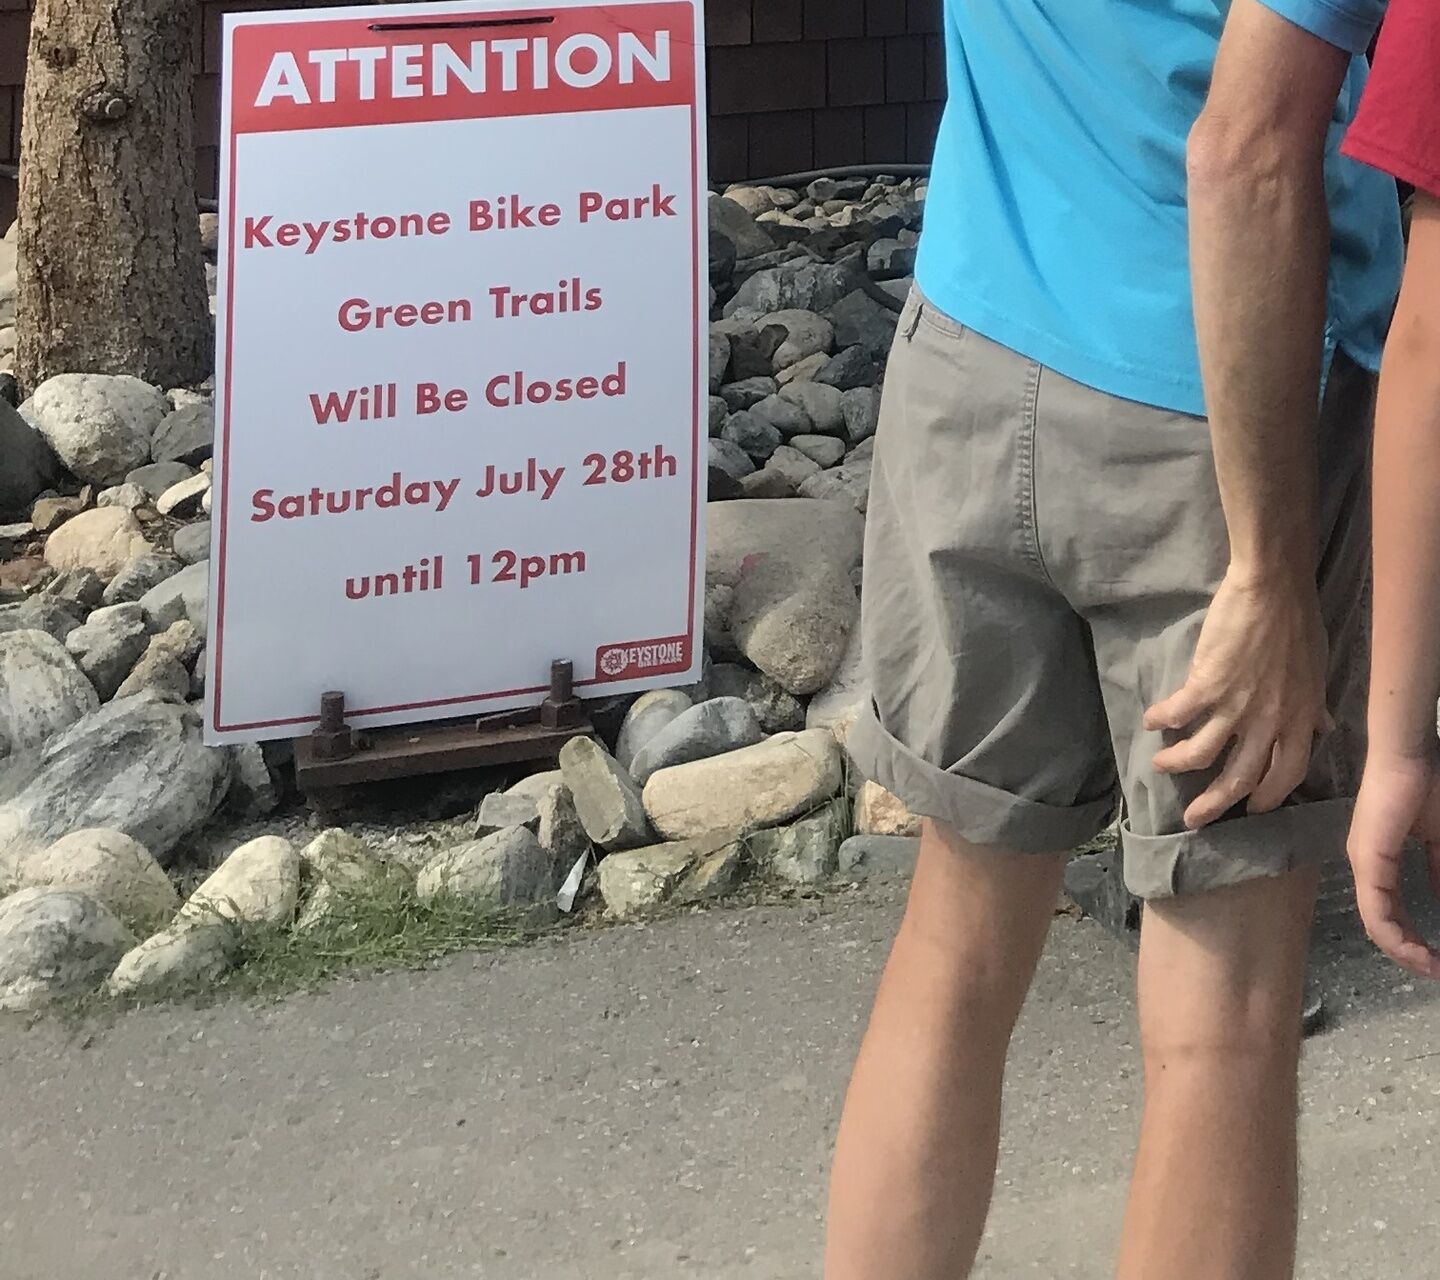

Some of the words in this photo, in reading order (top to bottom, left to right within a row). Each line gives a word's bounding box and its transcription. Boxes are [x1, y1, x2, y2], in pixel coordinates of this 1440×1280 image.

[254, 29, 671, 107] ATTENTION
[243, 213, 451, 253] Keystone
[468, 196, 562, 231] Bike
[579, 184, 676, 222] Park
[337, 298, 472, 332] Green
[489, 278, 604, 317] Trails
[309, 384, 396, 423] Will
[415, 383, 468, 414] Be
[485, 363, 628, 407] Closed
[251, 474, 460, 522] Saturday
[476, 459, 565, 500] July
[582, 447, 678, 485] 28th
[344, 557, 443, 599] until
[466, 550, 587, 587] 12pm
[620, 642, 683, 663] KEYSTONE
